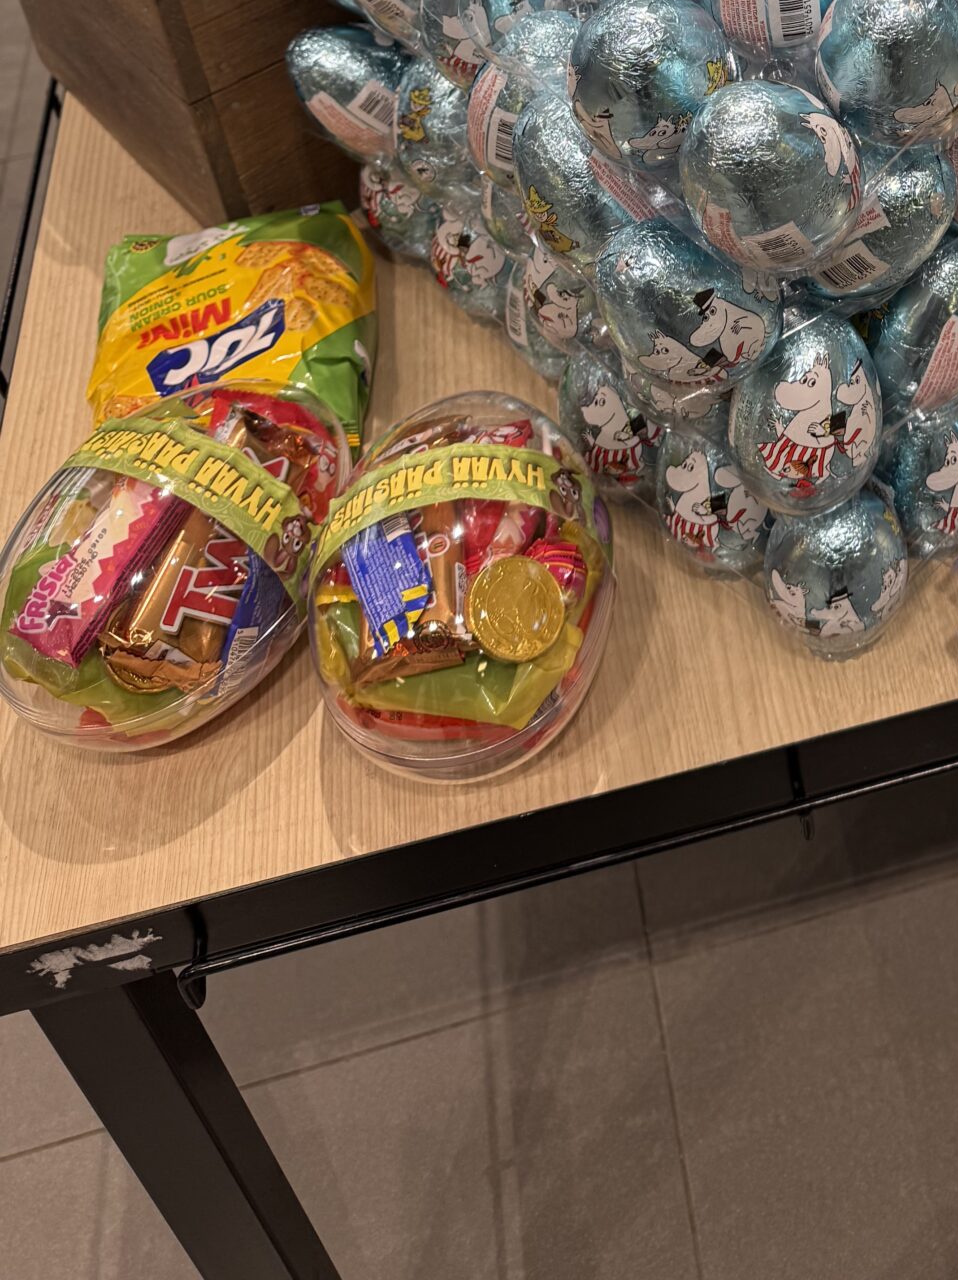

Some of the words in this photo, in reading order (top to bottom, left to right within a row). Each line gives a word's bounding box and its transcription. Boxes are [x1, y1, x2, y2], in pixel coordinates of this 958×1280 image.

[129, 294, 176, 321] ONION
[185, 282, 230, 307] SOUR
[130, 302, 182, 333] CREAM
[163, 305, 279, 386] TUC
[451, 456, 547, 491] HYVÄÄ
[189, 455, 283, 532] HYVÄÄ
